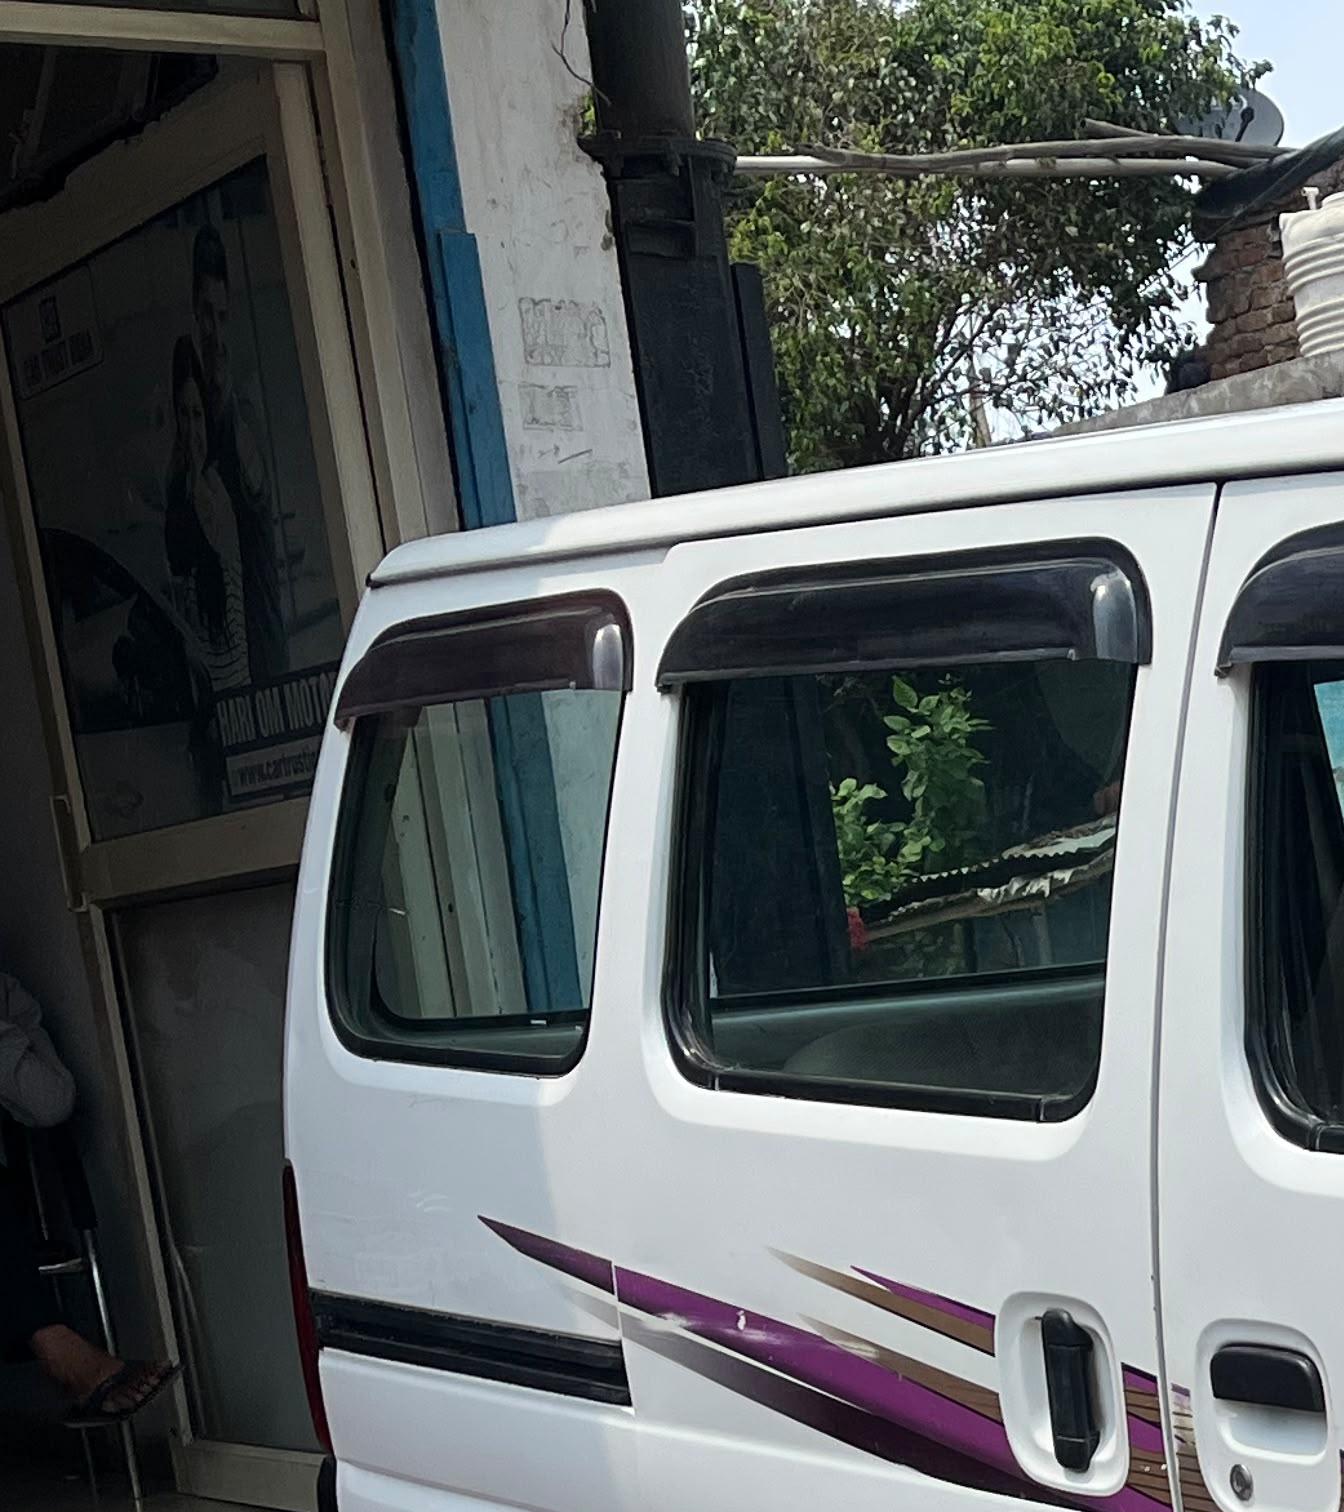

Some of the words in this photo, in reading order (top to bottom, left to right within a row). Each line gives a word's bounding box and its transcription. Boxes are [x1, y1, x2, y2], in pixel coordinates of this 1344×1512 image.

[216, 695, 256, 747] HARI
[255, 686, 285, 738] OM
[284, 672, 338, 730] MOTO
